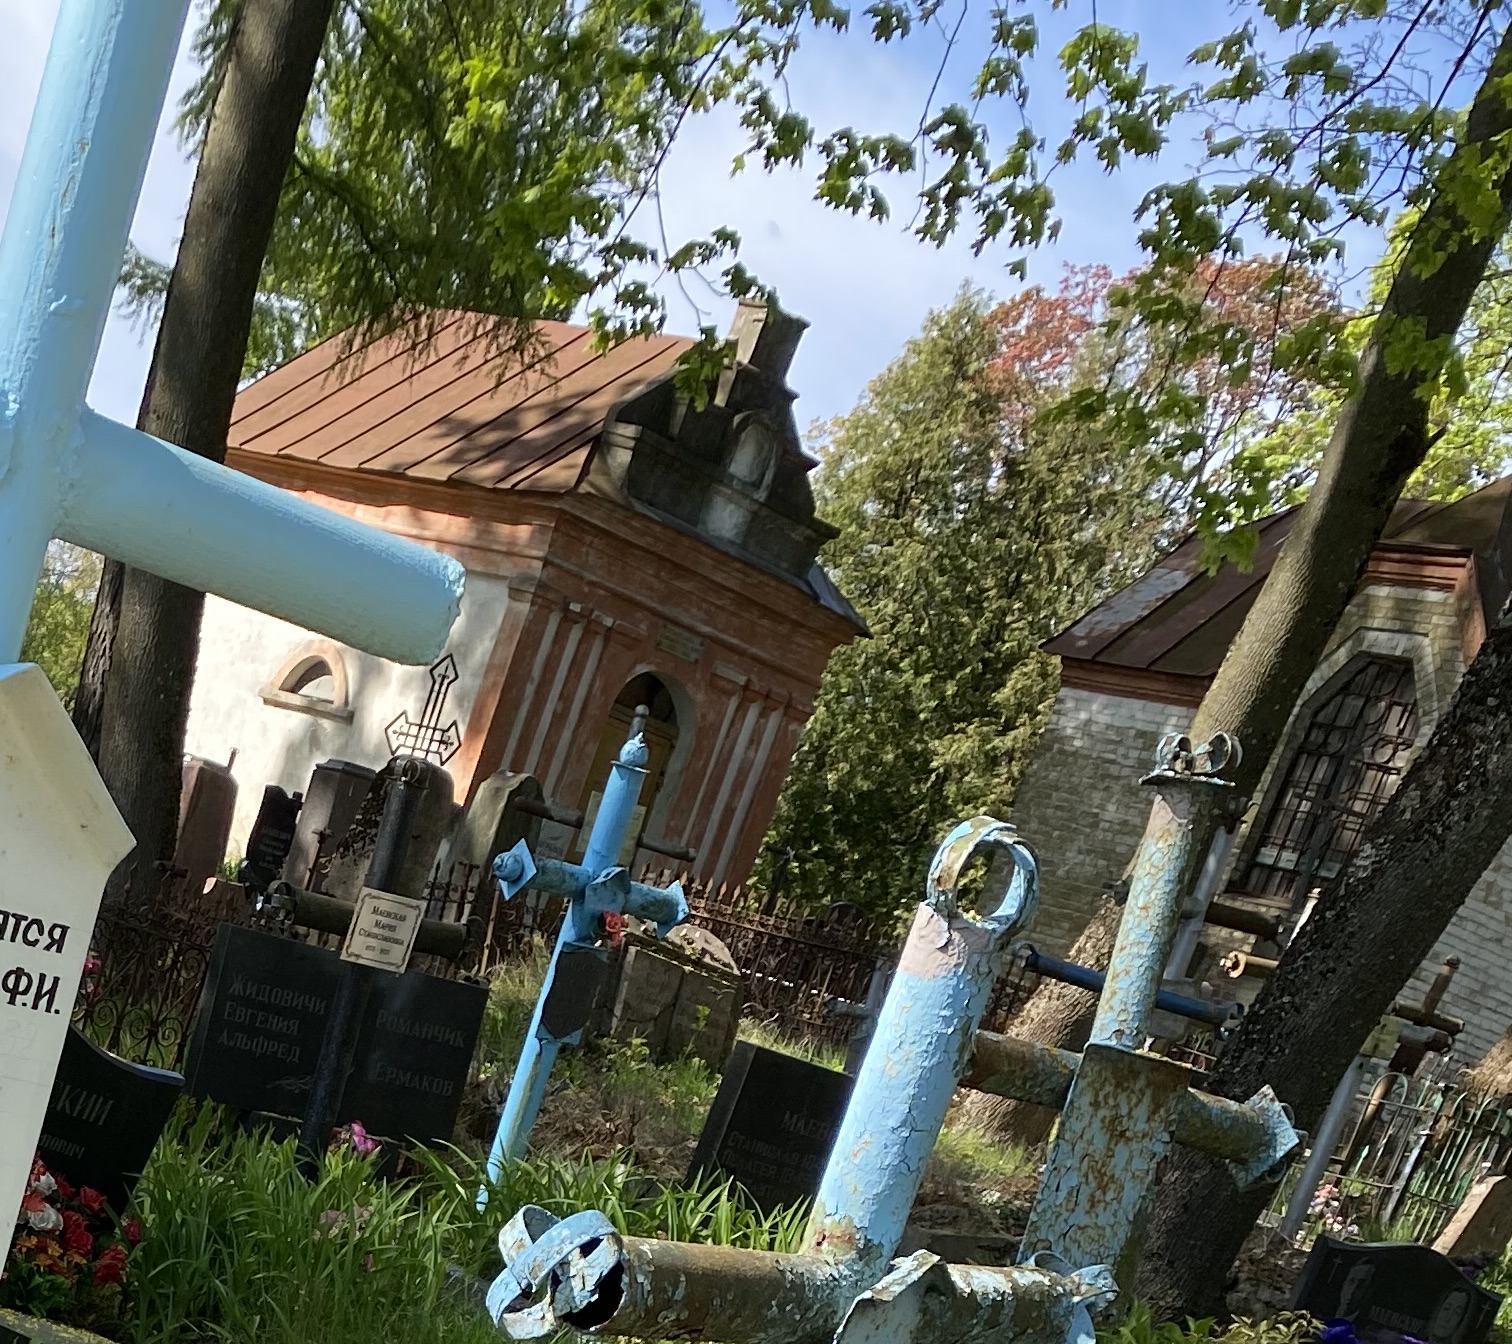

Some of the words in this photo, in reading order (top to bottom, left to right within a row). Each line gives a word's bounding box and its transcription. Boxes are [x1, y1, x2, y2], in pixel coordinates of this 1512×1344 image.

[0, 966, 62, 1015] Ф.И.
[227, 973, 329, 1018] ЖИДОВИЧИ
[222, 1000, 301, 1037] ЕВГЕНИЯ
[375, 1009, 468, 1049] РОМАНЧИК
[216, 1027, 301, 1065] АЛЬФРЕД
[374, 1061, 456, 1098] ЕРМАКОВ
